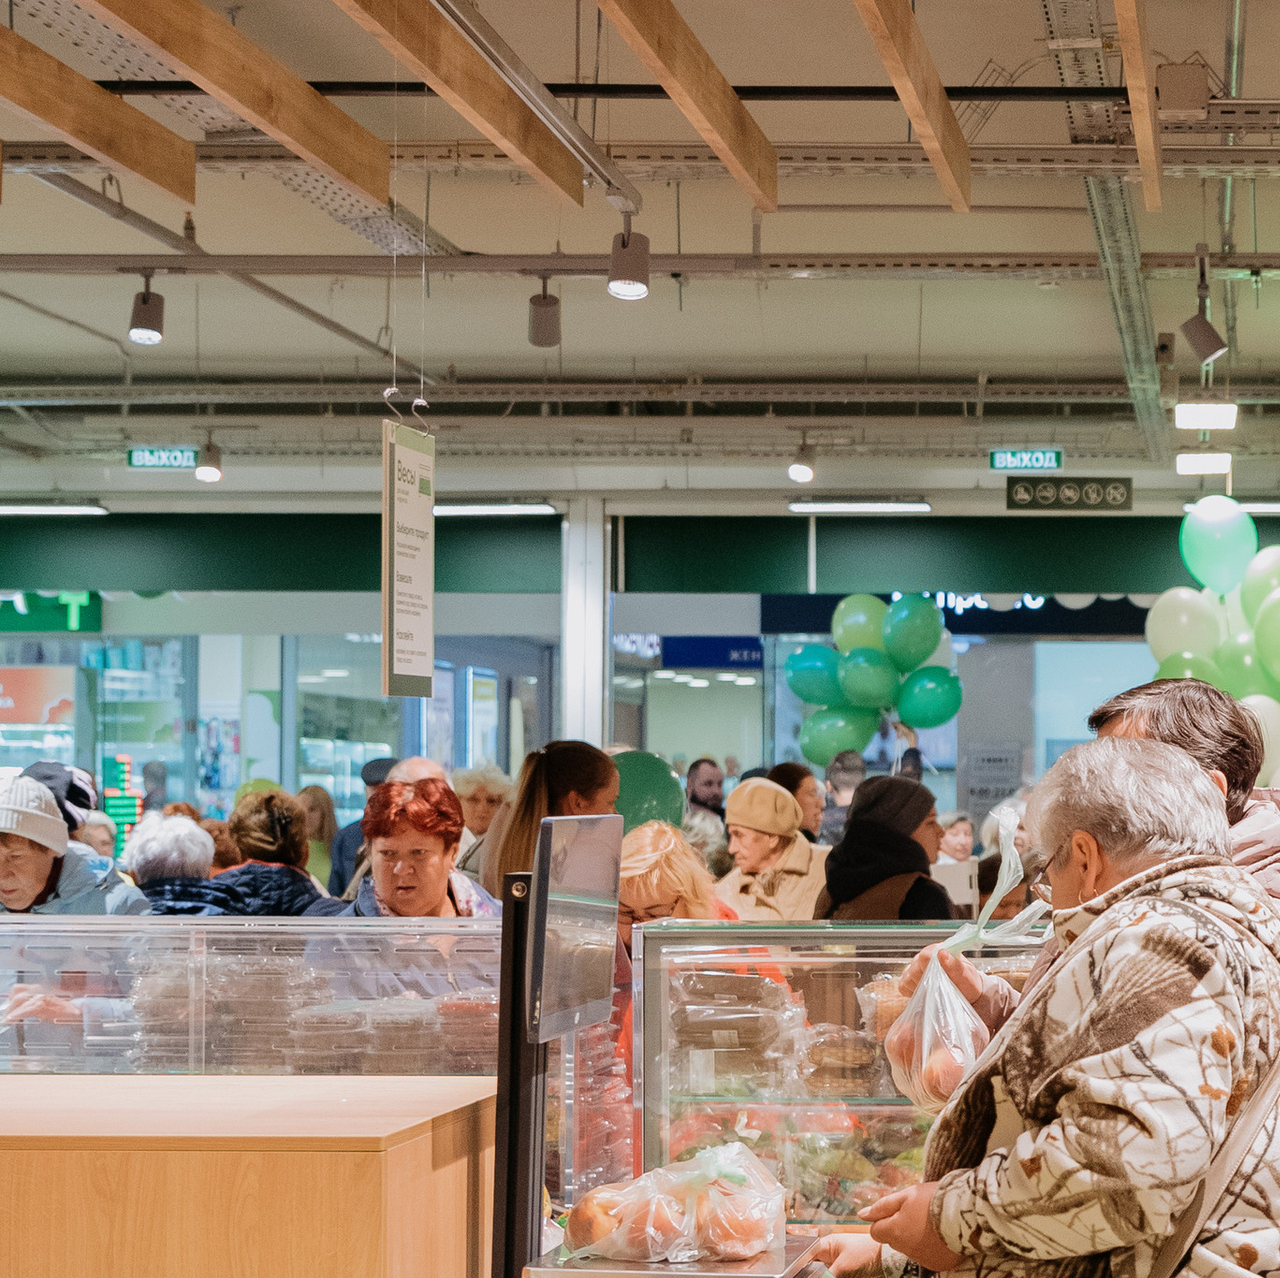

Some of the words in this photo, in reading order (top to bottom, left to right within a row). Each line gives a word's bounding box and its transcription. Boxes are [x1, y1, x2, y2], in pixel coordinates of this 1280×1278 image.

[132, 450, 196, 467] ВЫХОД
[993, 451, 1058, 468] ВЫХОД
[397, 459, 416, 485] Весы
